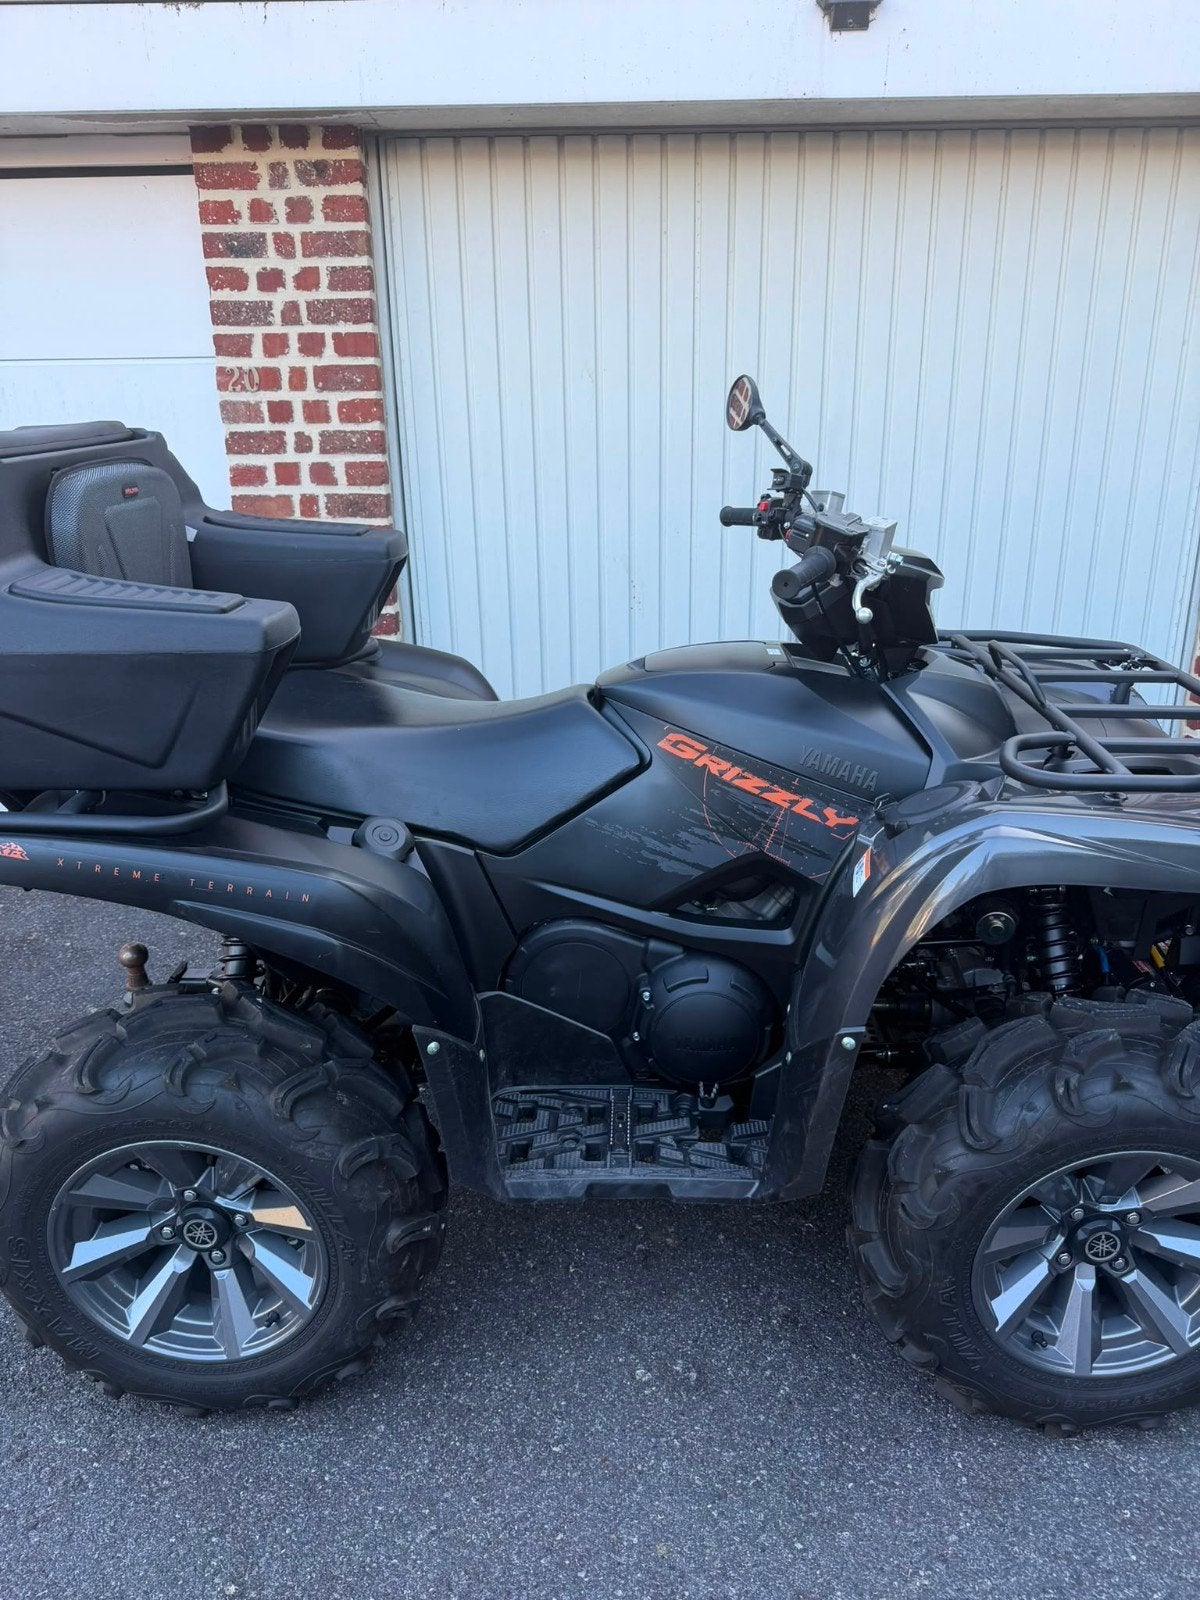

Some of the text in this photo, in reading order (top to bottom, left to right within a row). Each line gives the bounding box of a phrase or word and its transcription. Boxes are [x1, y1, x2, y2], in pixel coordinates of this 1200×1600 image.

[226, 367, 259, 392] 20
[657, 732, 860, 828] GRIZZLY
[799, 745, 879, 792] YAMAHA
[57, 857, 310, 903] XTREME TERRAIN
[7, 1235, 101, 1360] MAXXIS
